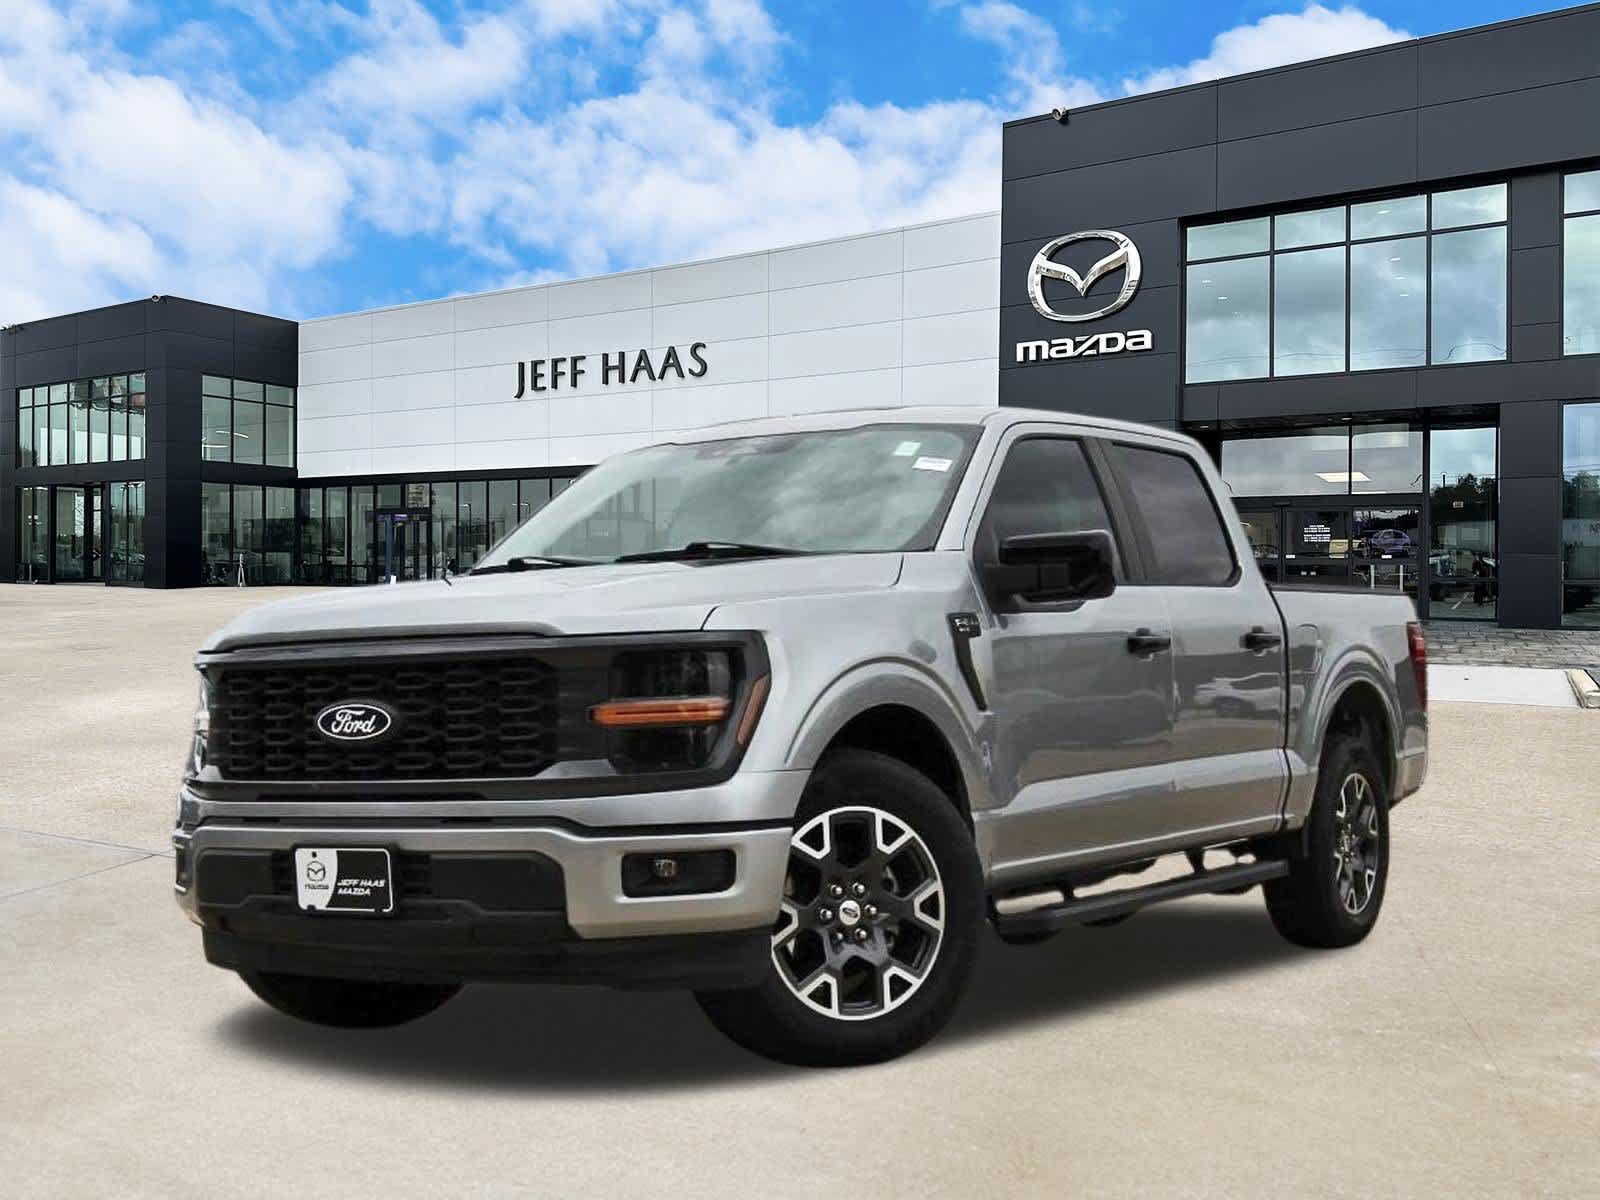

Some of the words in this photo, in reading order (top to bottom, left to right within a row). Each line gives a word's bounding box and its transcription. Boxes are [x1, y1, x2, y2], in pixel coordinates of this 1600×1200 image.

[513, 355, 587, 399] JEFF
[601, 342, 708, 385] HAAS
[331, 709, 376, 733] Ford
[337, 887, 371, 896] MAZDA
[359, 879, 386, 888] HAAS
